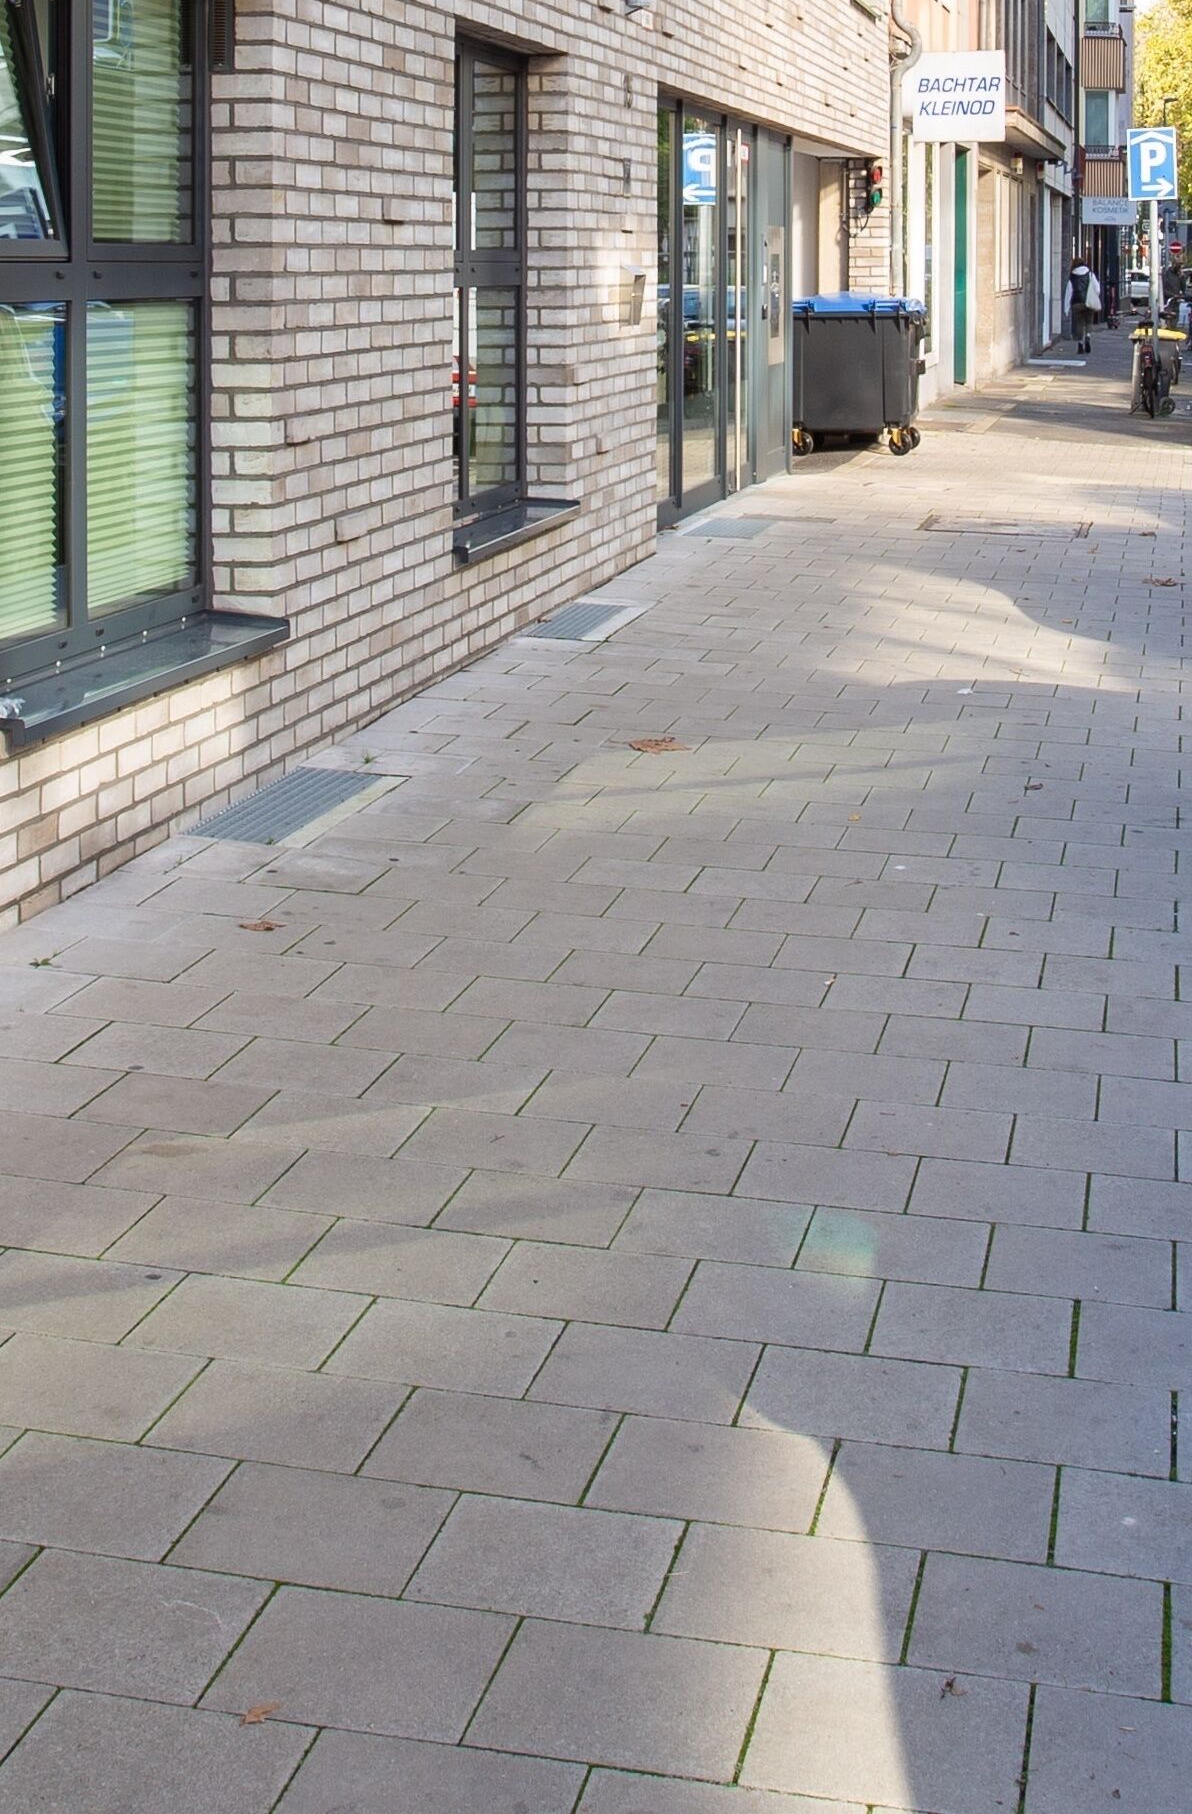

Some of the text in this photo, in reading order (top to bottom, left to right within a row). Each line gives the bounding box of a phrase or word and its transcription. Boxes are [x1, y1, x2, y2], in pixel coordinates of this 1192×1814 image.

[918, 77, 1001, 93] BACHTAR
[919, 100, 995, 116] KLEINOD
[1140, 142, 1166, 183] P
